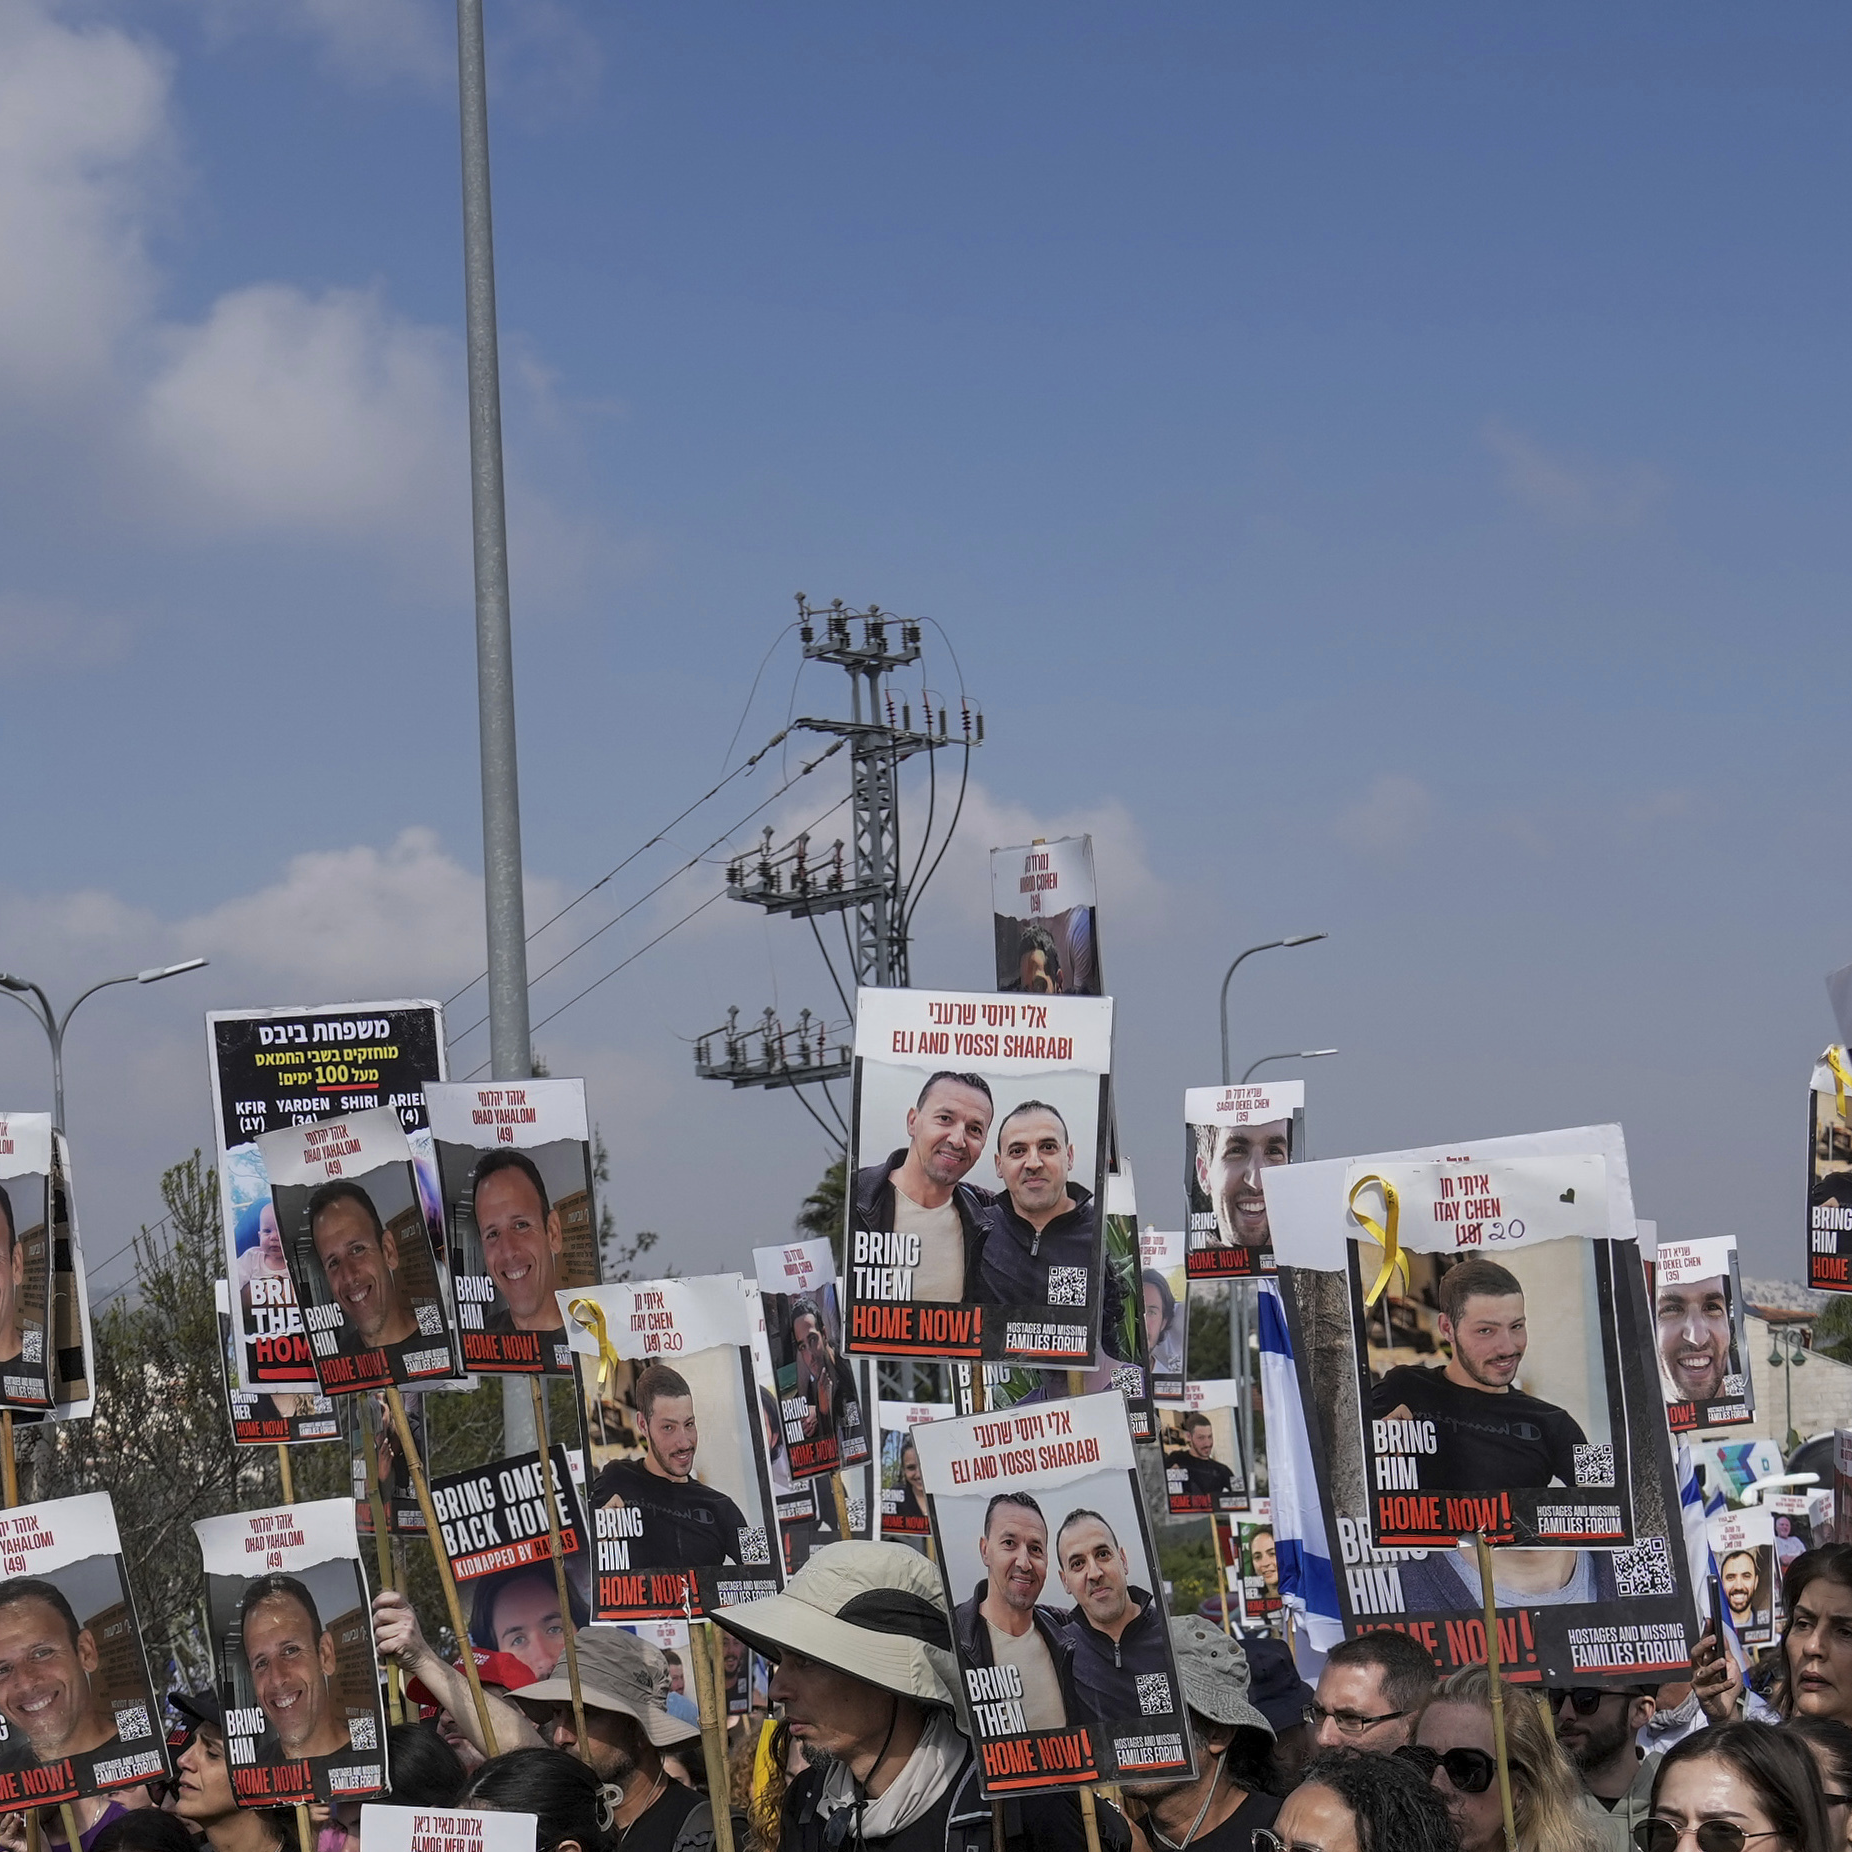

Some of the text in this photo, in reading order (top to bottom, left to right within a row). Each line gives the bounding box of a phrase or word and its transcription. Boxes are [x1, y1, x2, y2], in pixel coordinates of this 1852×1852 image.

[1037, 872, 1057, 892] COHEN
[929, 1002, 1047, 1029] אלי שרעבי
[259, 1018, 391, 1045] משפחת ביבס
[893, 1030, 1073, 1060] ELI AND YOSSI SHARABI
[254, 1045, 399, 1067] מוחזקים בשבי החמאס
[278, 1065, 379, 1086] מעל 100 ימים!
[235, 1100, 267, 1115] KFIR
[276, 1096, 330, 1112] YARDEN
[340, 1095, 378, 1110] SHIRI
[239, 1116, 266, 1132] (1Y)
[400, 1108, 419, 1125] (4)
[1236, 1112, 1249, 1123] (35)
[1456, 1173, 1490, 1196] איתי
[1433, 1196, 1501, 1222] ITAY CHEN
[1488, 1218, 1526, 1242] 20
[1684, 1256, 1701, 1267] CHEN
[853, 1266, 913, 1303] THEM
[1665, 1270, 1679, 1282] (35)
[630, 1312, 674, 1332] ITAY CHEN
[852, 1304, 912, 1342] HOME
[1007, 1321, 1087, 1337] HOSTAGES AND MISSING
[664, 1332, 684, 1351] 20
[1006, 1334, 1087, 1353] FAMILIES FORUM
[233, 1405, 252, 1420] HER
[951, 1437, 1101, 1486] ELI YOSSI SHARABI
[499, 1459, 563, 1504] OMER
[1378, 1495, 1442, 1531] HOME
[440, 1512, 502, 1557] BACK
[1537, 1517, 1622, 1534] FAMILIES FORUM
[244, 1535, 264, 1555] OHAD
[265, 1550, 282, 1569] (49)
[455, 1543, 533, 1578] KIDNAPPED BY
[1567, 1622, 1685, 1646] HOSTAGES MISSING
[133, 1760, 163, 1781] FORUM
[433, 1816, 482, 1836] אלמוג מאיר
[411, 1836, 442, 1852] ALMOG
